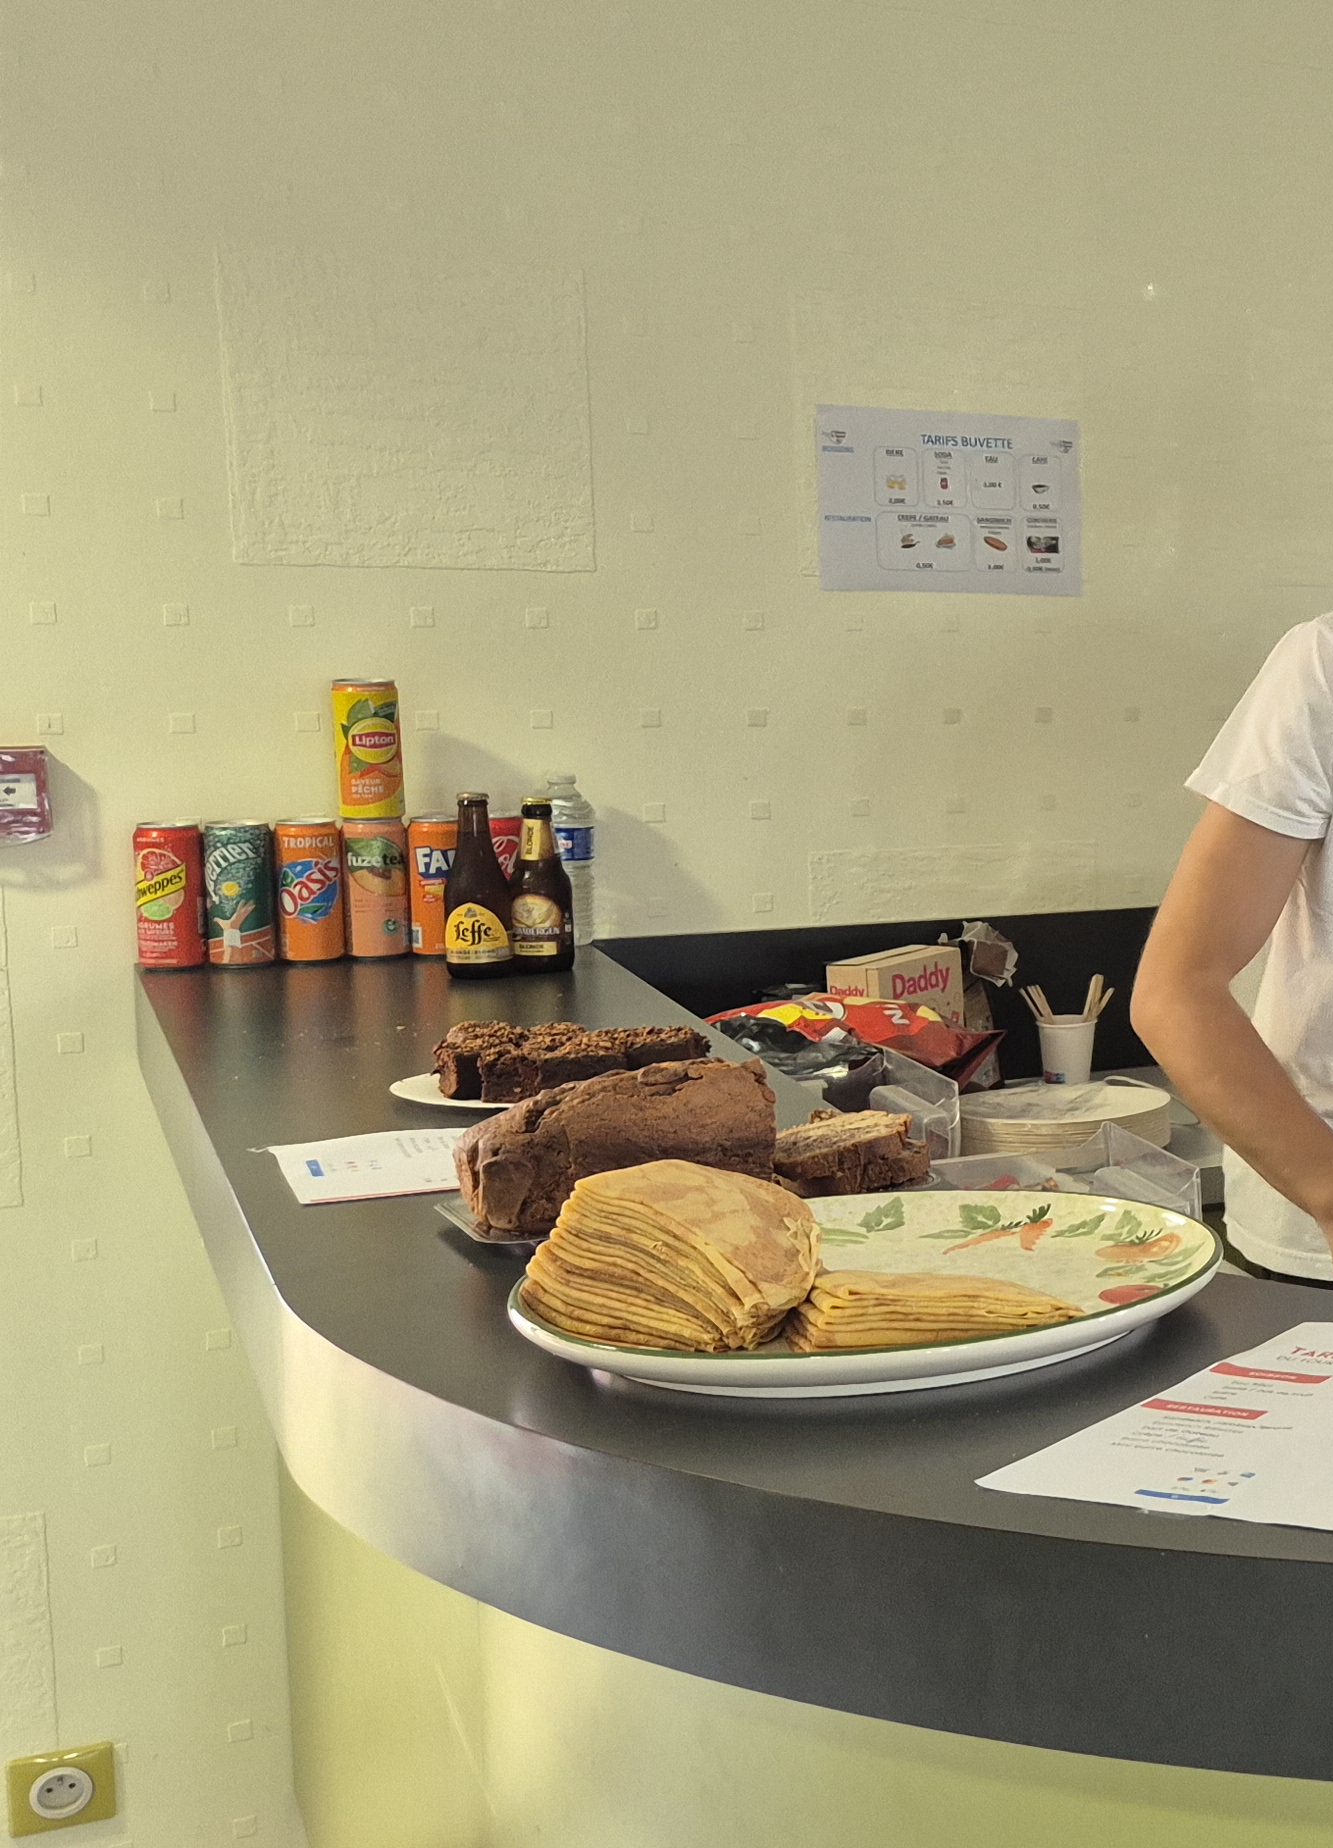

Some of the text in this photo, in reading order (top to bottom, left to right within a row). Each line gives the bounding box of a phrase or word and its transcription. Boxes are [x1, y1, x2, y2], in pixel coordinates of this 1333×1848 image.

[920, 434, 1014, 450] TARIFS BUVETTE
[354, 734, 394, 747] Lipton
[283, 836, 335, 849] TROPICAL
[280, 860, 340, 919] Oasis
[453, 919, 494, 947] Leffe
[892, 961, 950, 1000] Daddy
[829, 985, 866, 998] Daddy
[1165, 1403, 1250, 1417] RESTAURATION
